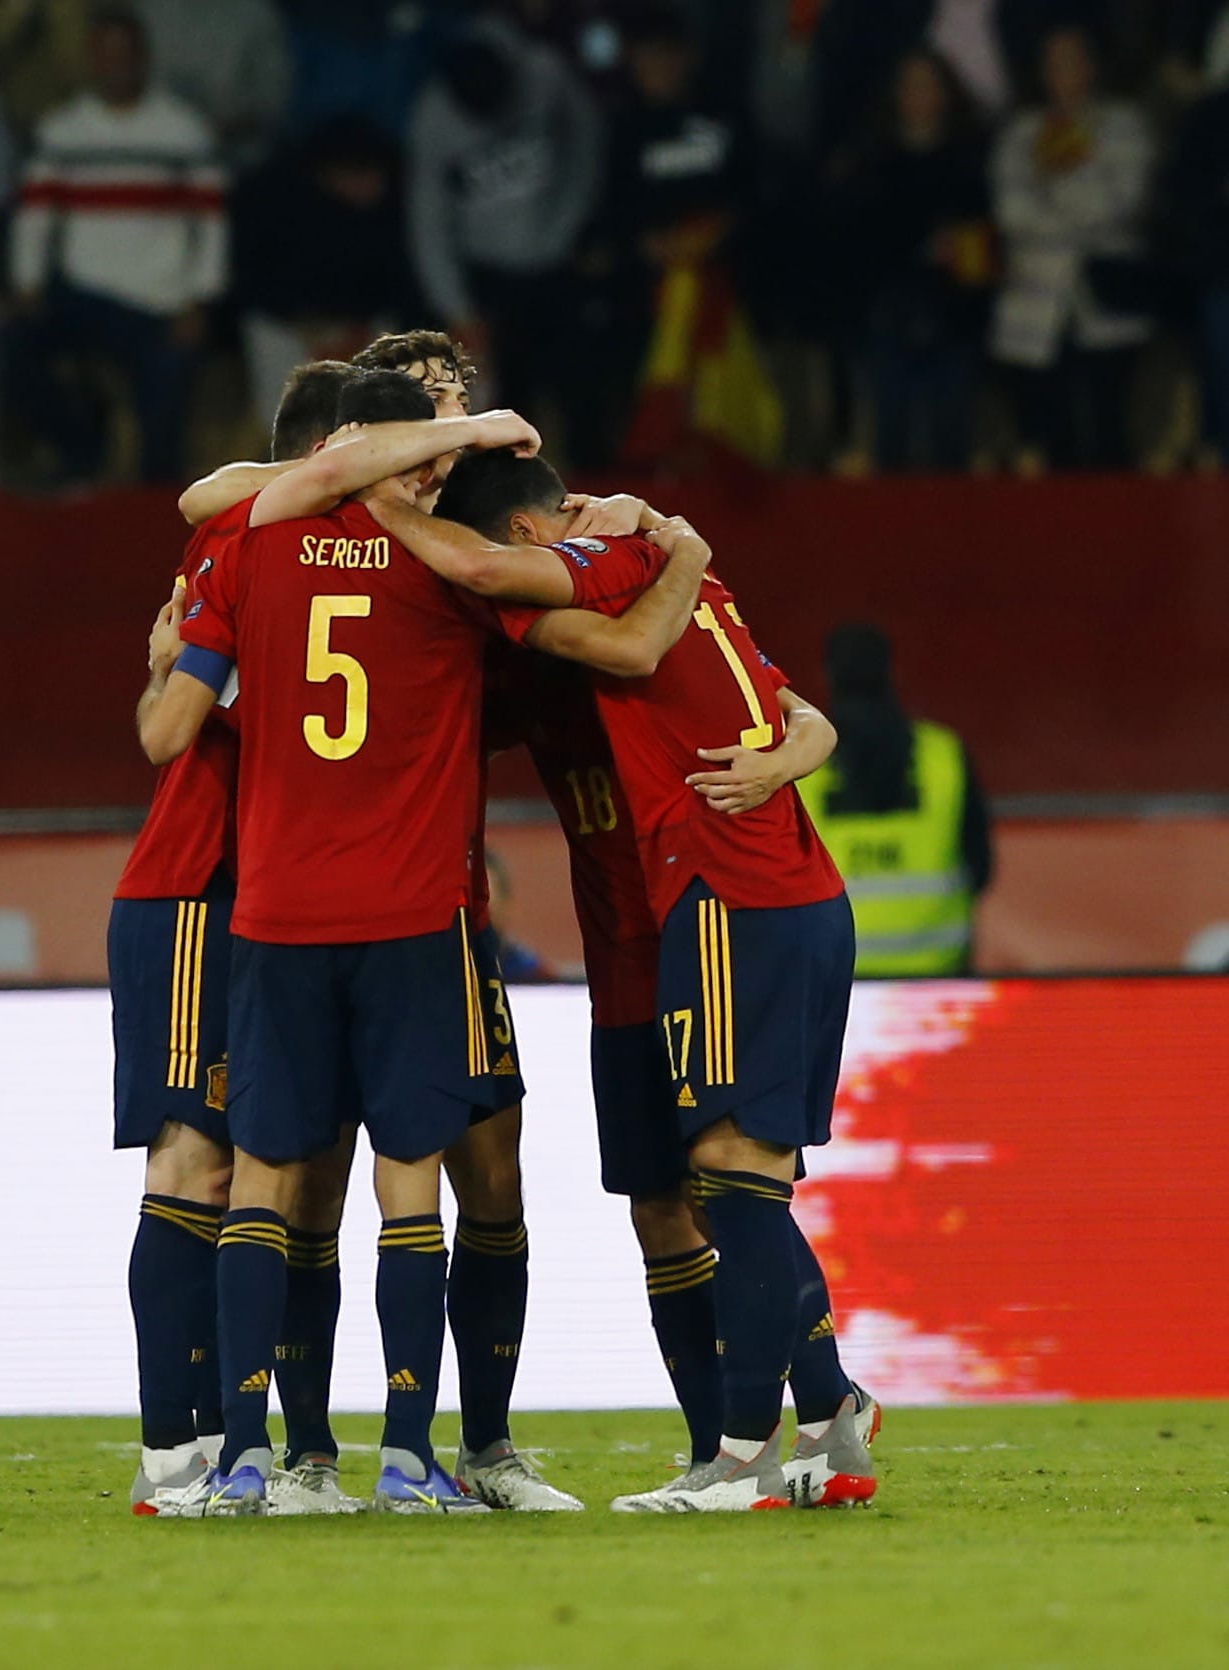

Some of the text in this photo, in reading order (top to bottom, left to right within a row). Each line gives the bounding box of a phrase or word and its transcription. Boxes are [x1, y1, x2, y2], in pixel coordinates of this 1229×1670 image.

[298, 534, 390, 570] SERGIO
[303, 594, 371, 761] 5
[566, 766, 618, 834] 18
[662, 1008, 693, 1081] 17
